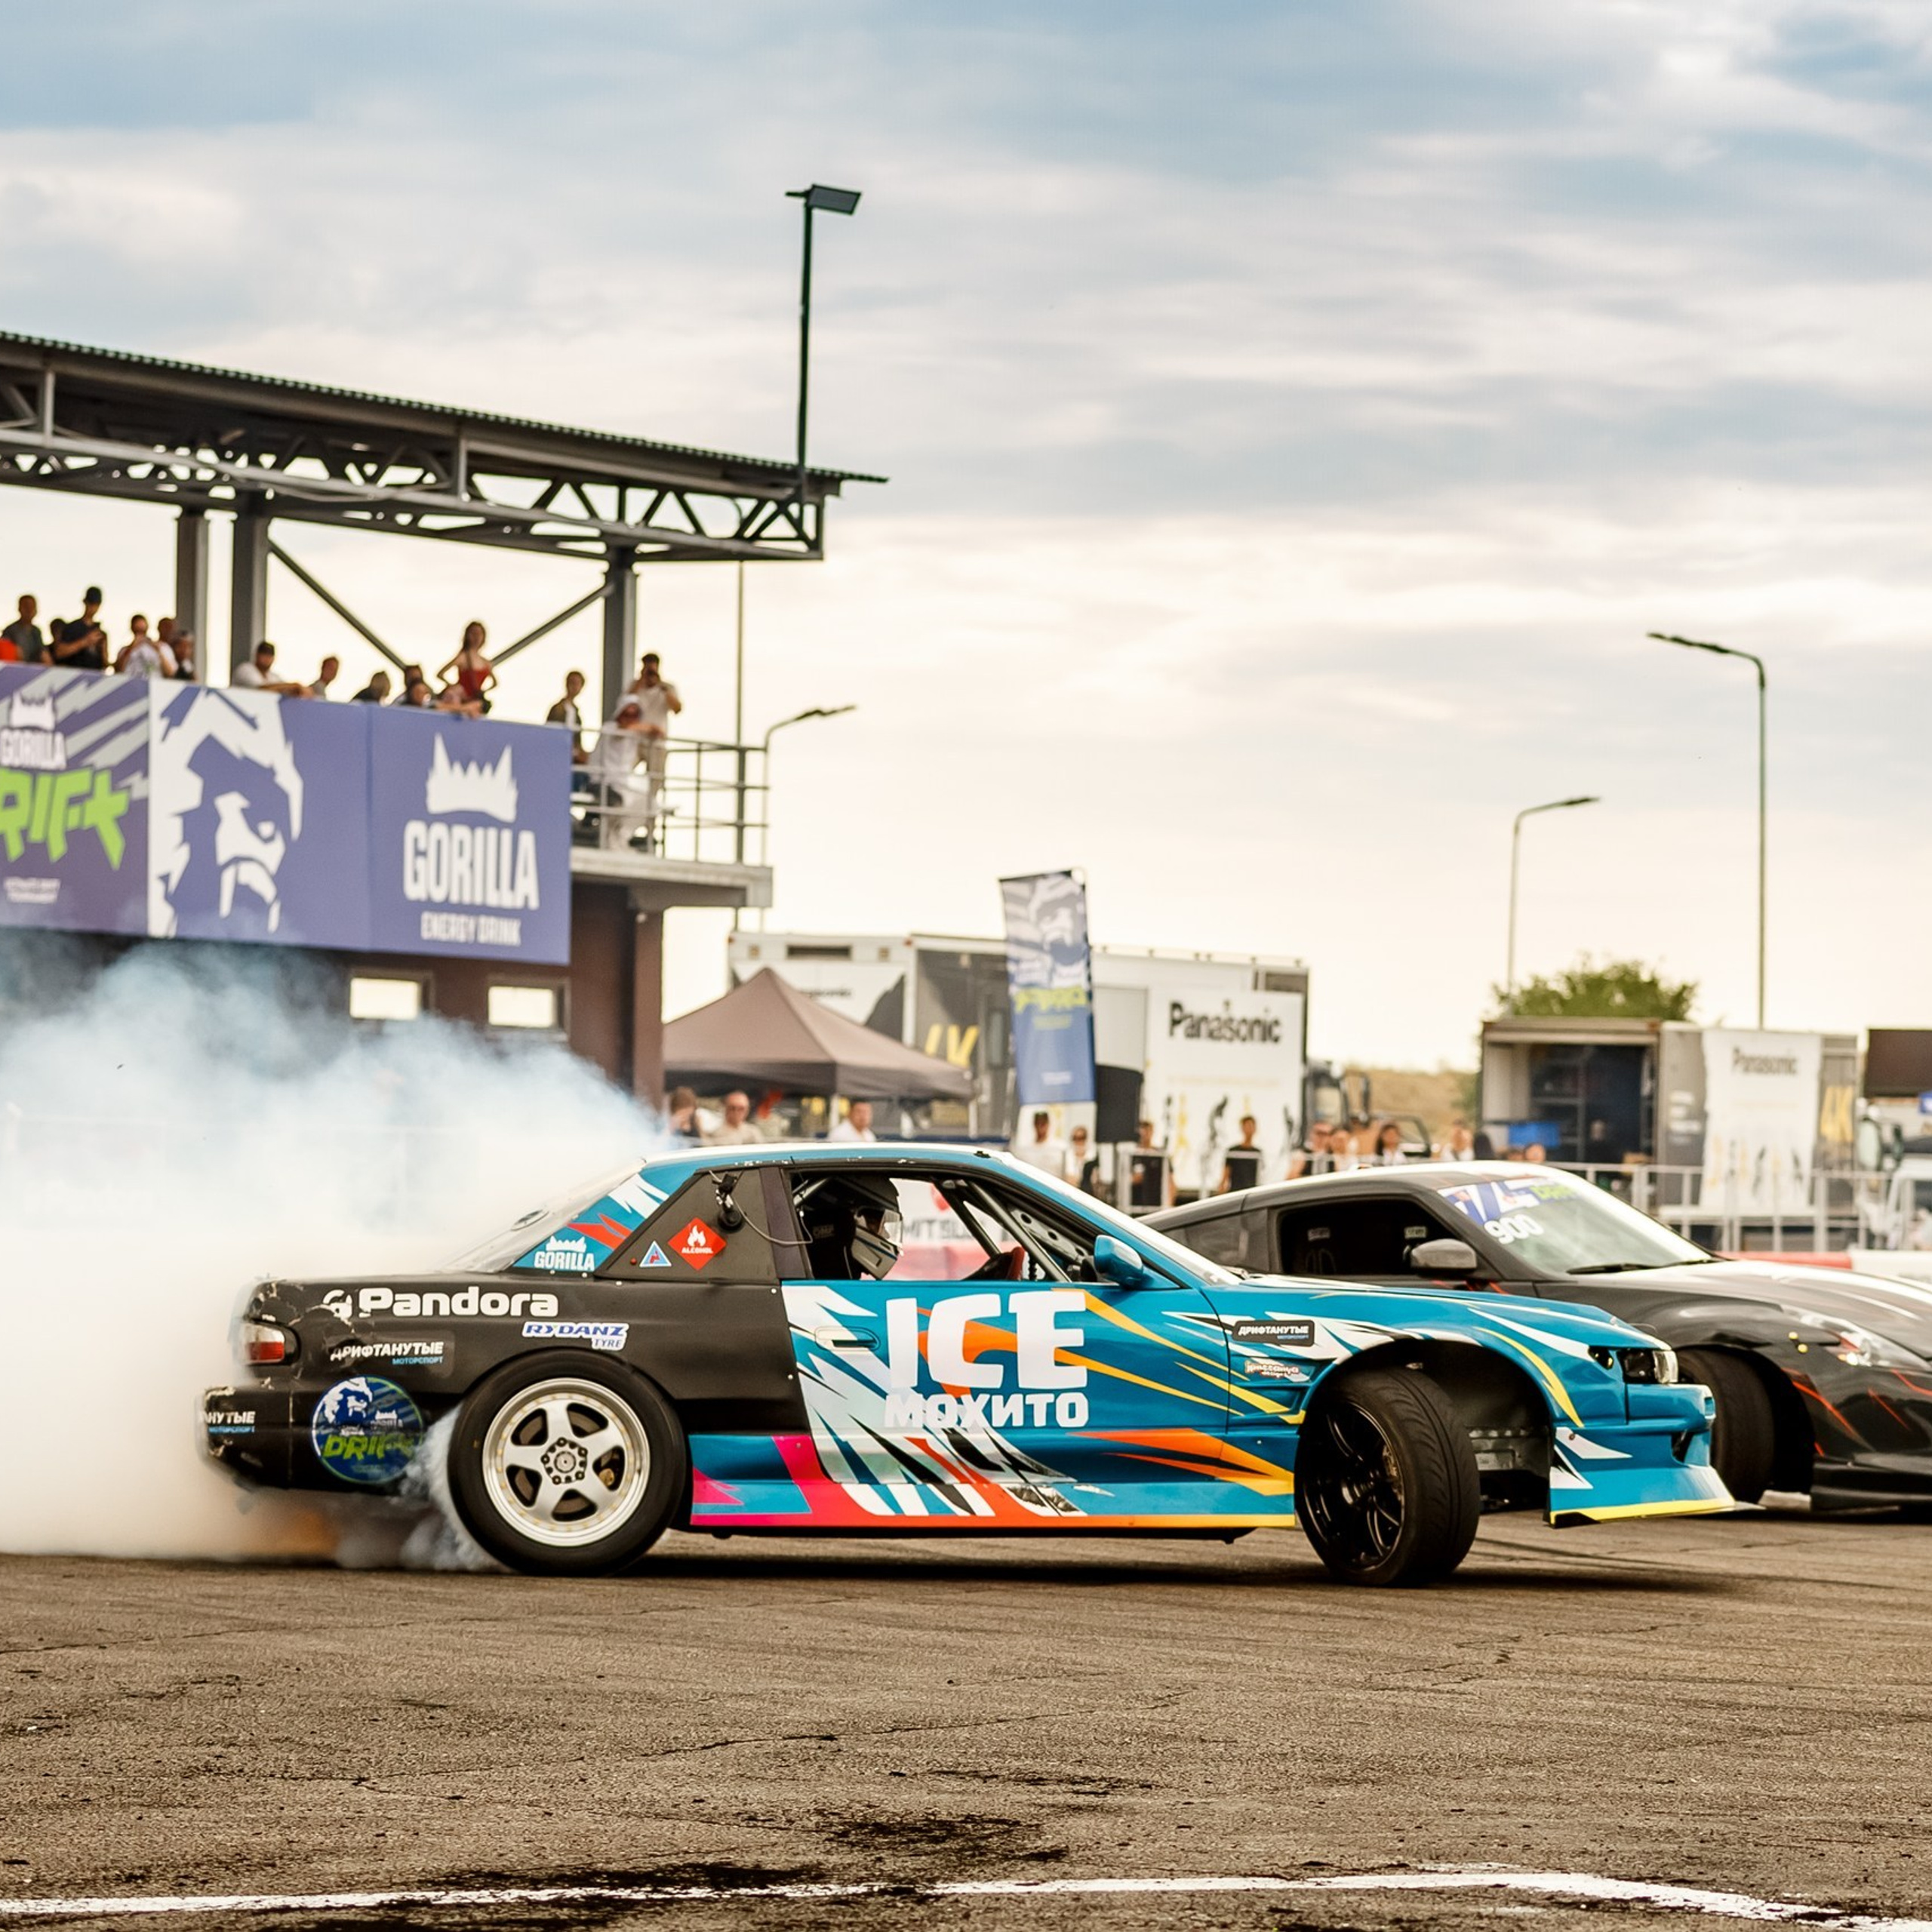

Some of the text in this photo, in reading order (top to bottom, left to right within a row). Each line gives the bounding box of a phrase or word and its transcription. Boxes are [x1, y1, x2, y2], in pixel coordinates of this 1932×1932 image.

[403, 820, 540, 910] GORILLA
[1168, 999, 1282, 1044] Panasonic
[1484, 1214, 1544, 1244] 900
[534, 1251, 595, 1272] GORILLA
[358, 1286, 558, 1318] Pandora
[526, 1324, 625, 1337] RYDANZ
[594, 1339, 622, 1349] TYRE
[885, 1291, 1088, 1389] ICE
[884, 1393, 1089, 1428] МОХИТО
